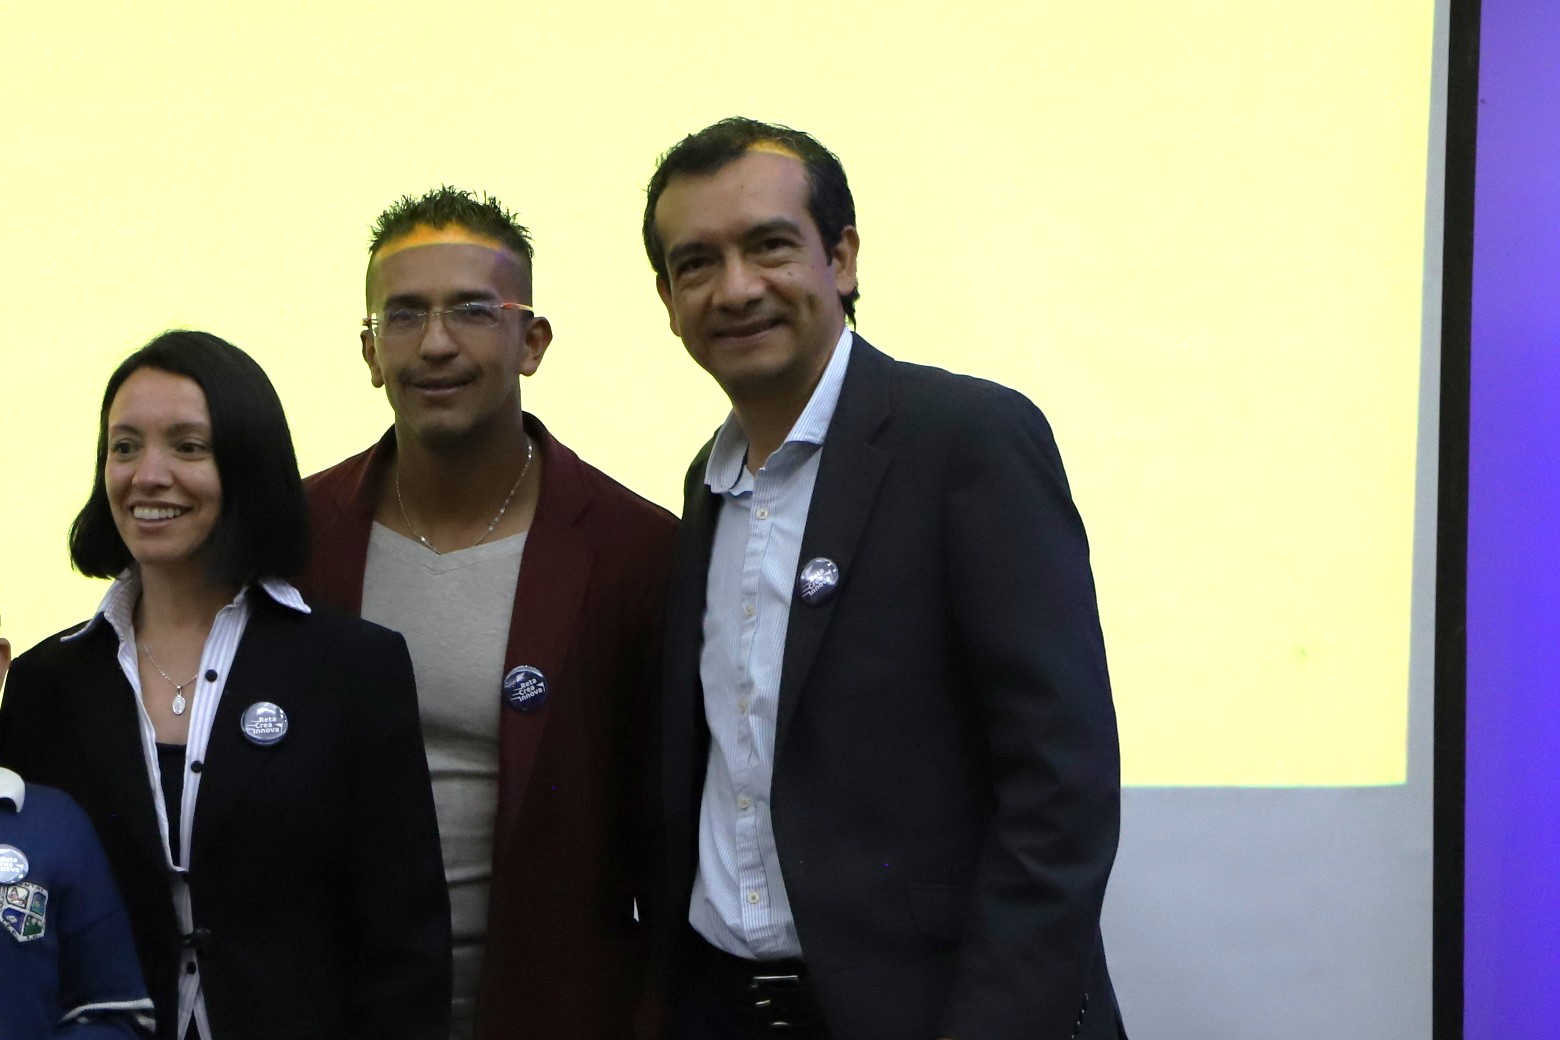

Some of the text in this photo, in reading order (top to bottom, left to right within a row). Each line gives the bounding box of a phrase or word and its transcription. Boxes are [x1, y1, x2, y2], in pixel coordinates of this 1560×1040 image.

[520, 678, 537, 689] Reta
[518, 685, 535, 697] Crea
[518, 687, 543, 702] Innova
[253, 727, 280, 735] Innova
